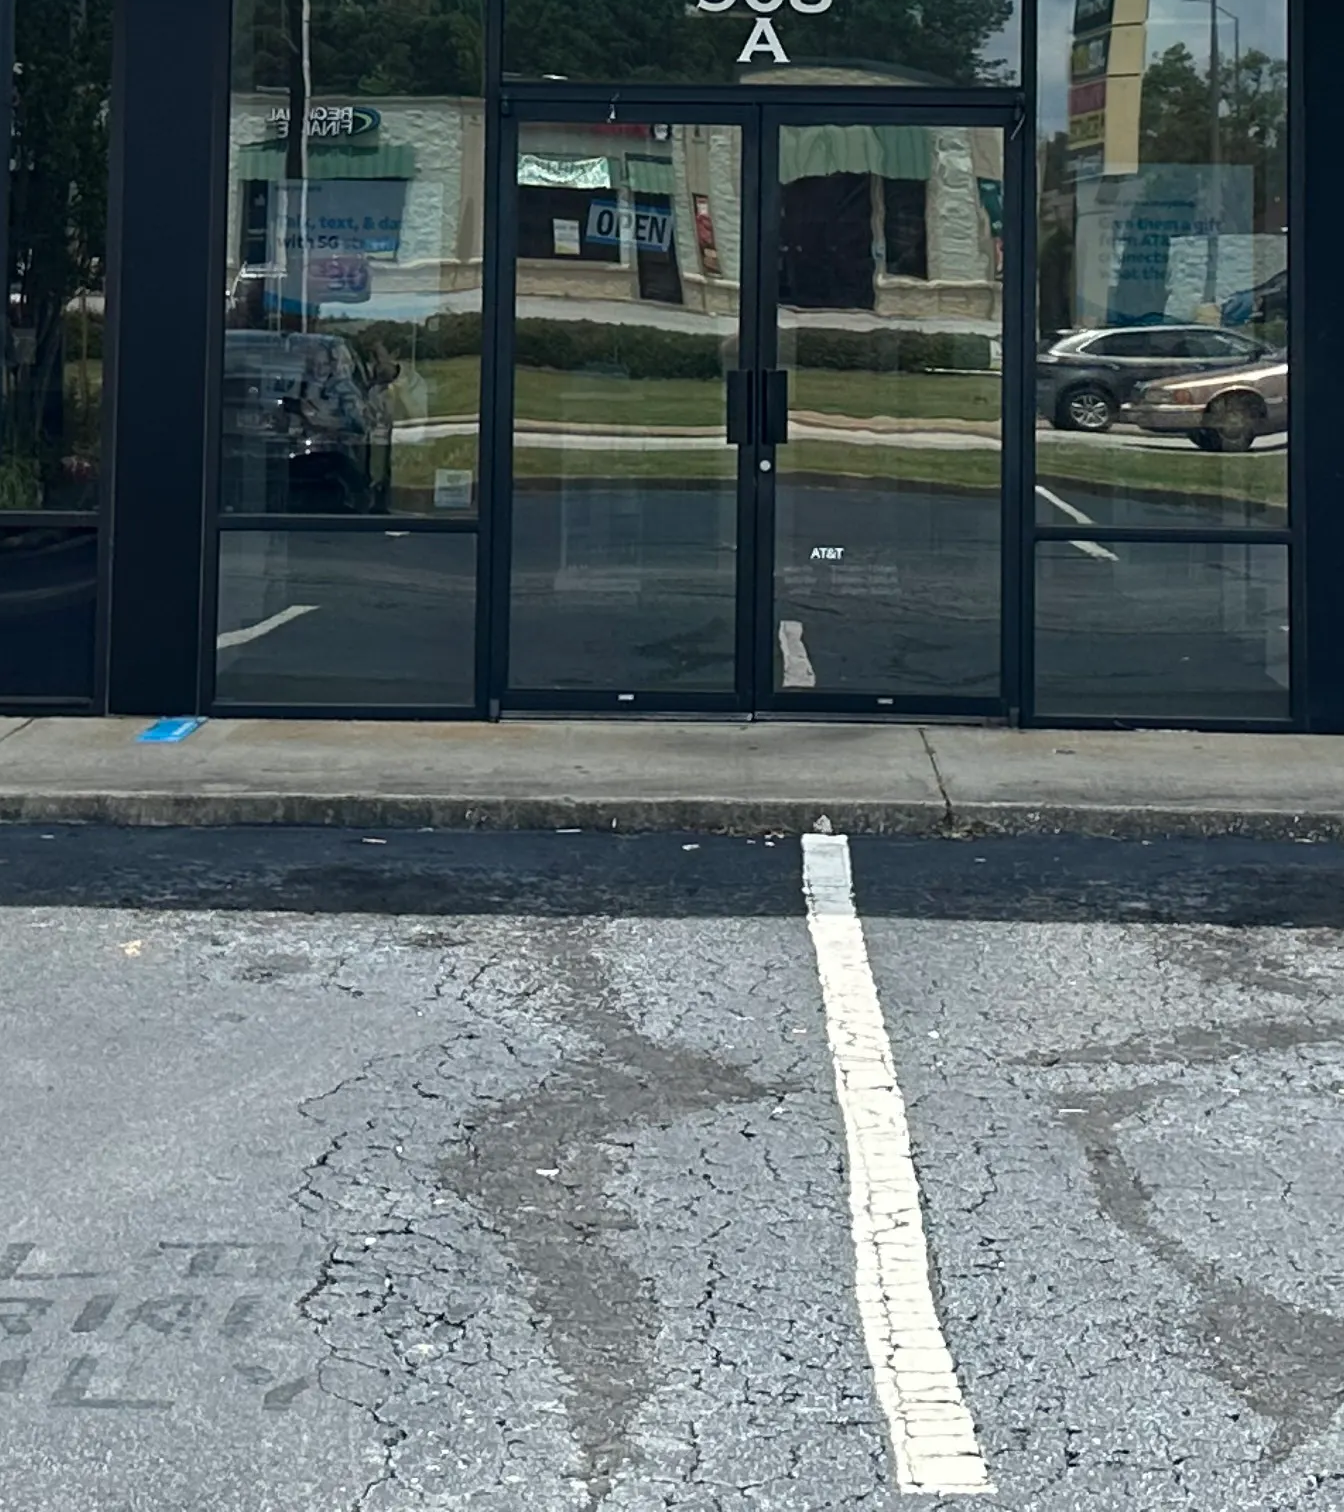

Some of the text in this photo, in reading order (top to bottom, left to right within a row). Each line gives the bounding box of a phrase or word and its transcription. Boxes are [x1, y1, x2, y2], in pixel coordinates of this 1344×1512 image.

[736, 17, 791, 63] A
[596, 209, 667, 244] OPEN
[810, 547, 844, 560] AT&T
